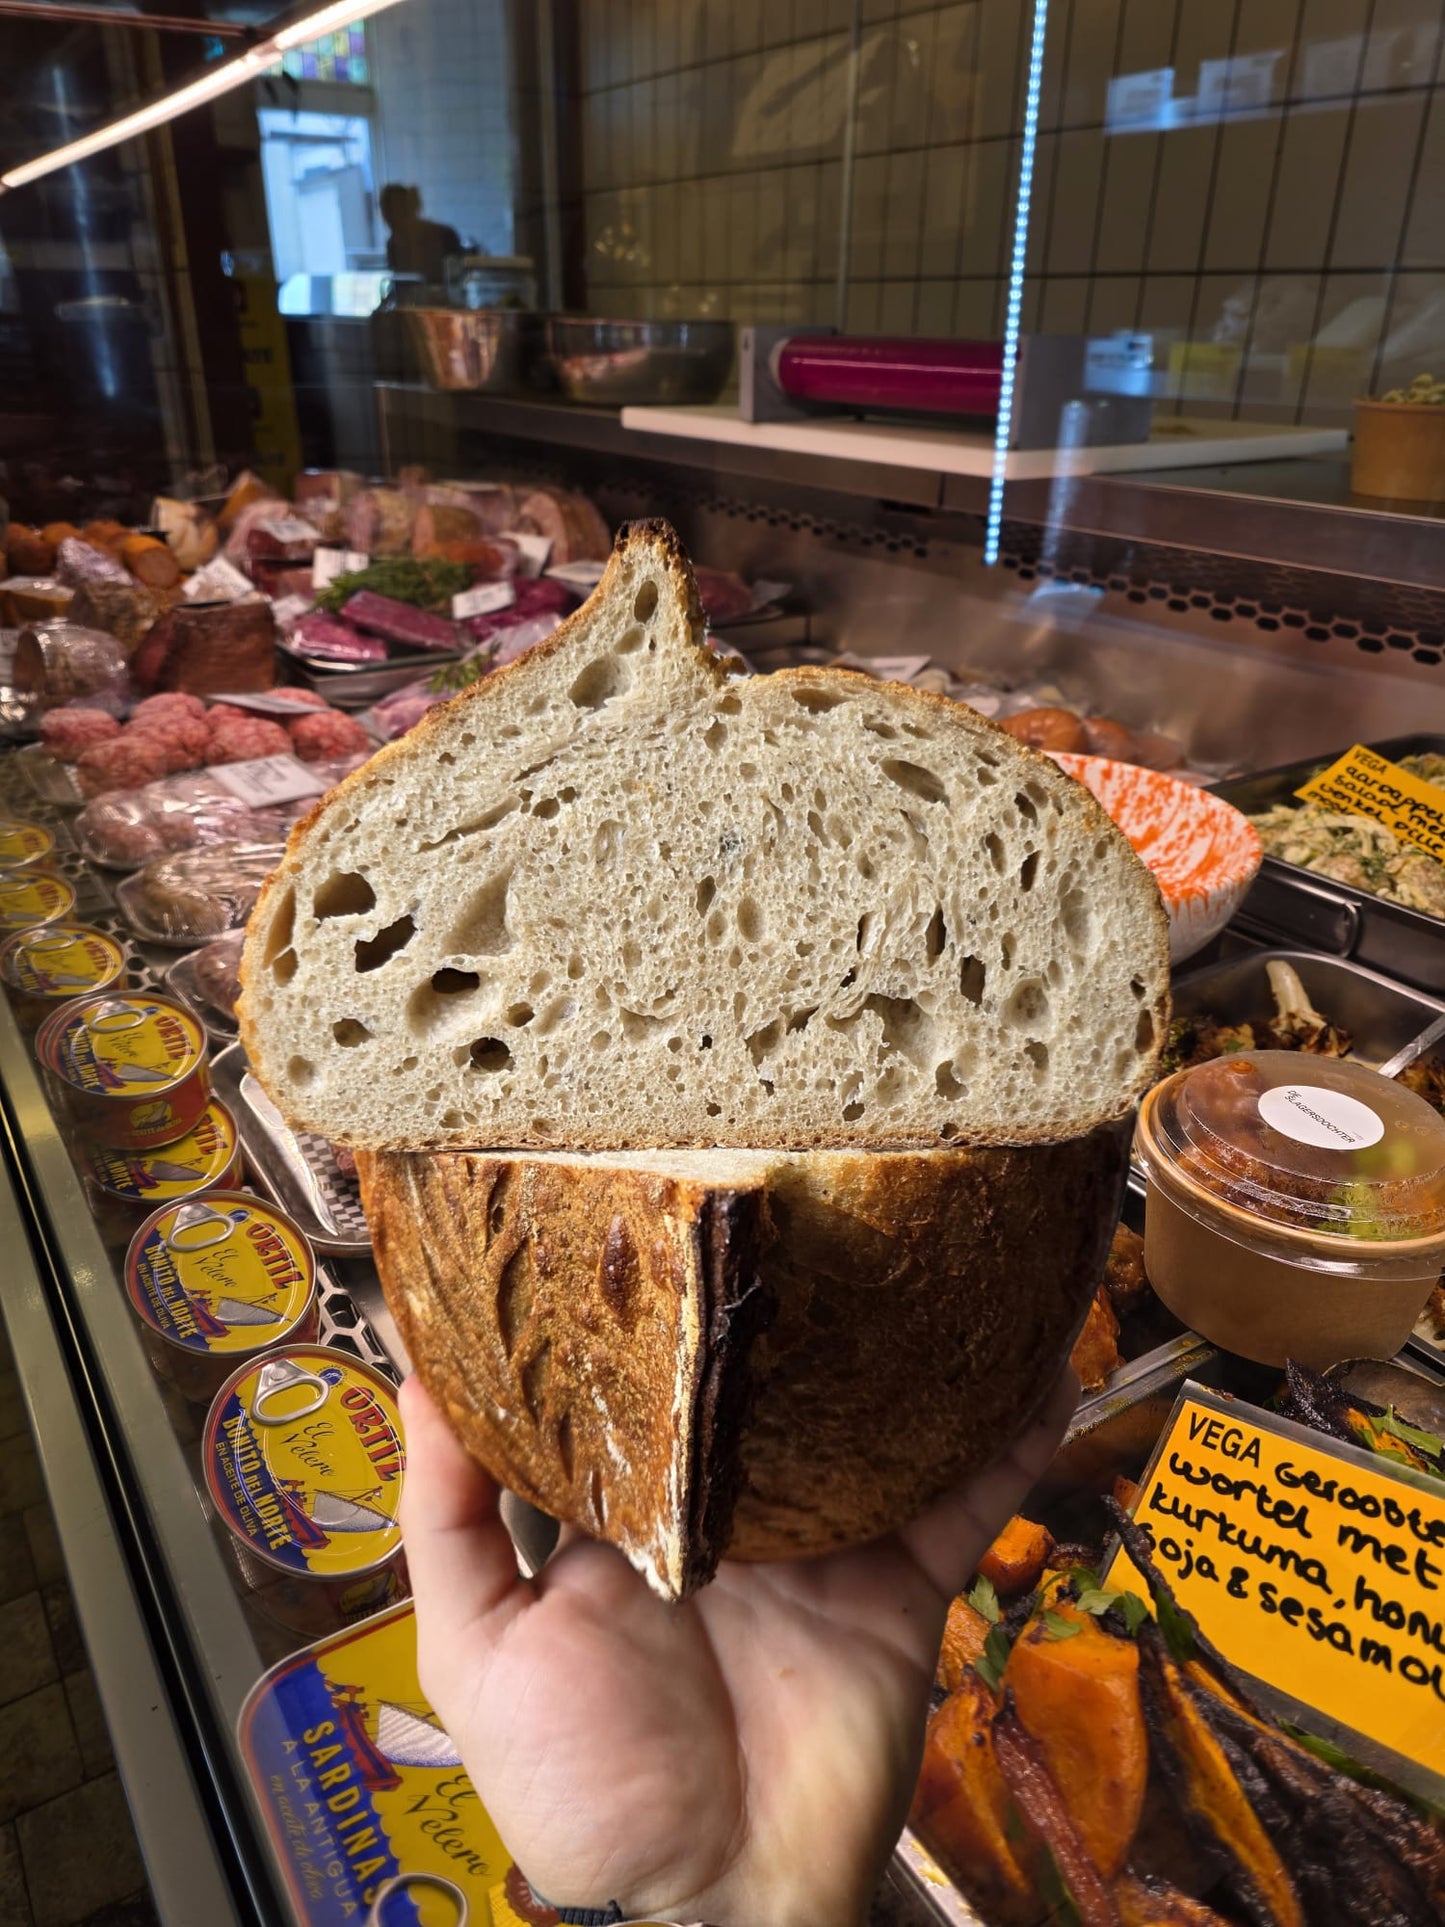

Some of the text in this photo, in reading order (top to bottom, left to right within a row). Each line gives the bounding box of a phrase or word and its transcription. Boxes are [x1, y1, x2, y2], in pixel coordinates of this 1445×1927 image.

[1354, 750, 1387, 775] VEGA
[154, 1015, 195, 1060] ORTIZ
[1285, 1095, 1356, 1143] SLAGERSDOCHTER
[192, 1257, 237, 1288] Velero
[212, 1249, 239, 1261] El
[246, 1222, 305, 1290] ORTIZ
[145, 1243, 199, 1340] BONITO DEL NORTE
[156, 1309, 171, 1329] OLIVA
[281, 1433, 336, 1477] Velero
[304, 1423, 336, 1439] El
[340, 1386, 407, 1482] ORTIZ
[1188, 1412, 1261, 1468] VEGA
[216, 1442, 255, 1537] EN ACEITE DE OLIVA
[222, 1414, 293, 1550] BONITO DEL NORTE
[1169, 1452, 1443, 1590] wortel met
[436, 1774, 479, 1807] El
[281, 1740, 358, 1919] A LA ANTIGUA
[404, 1794, 493, 1877] Velero
